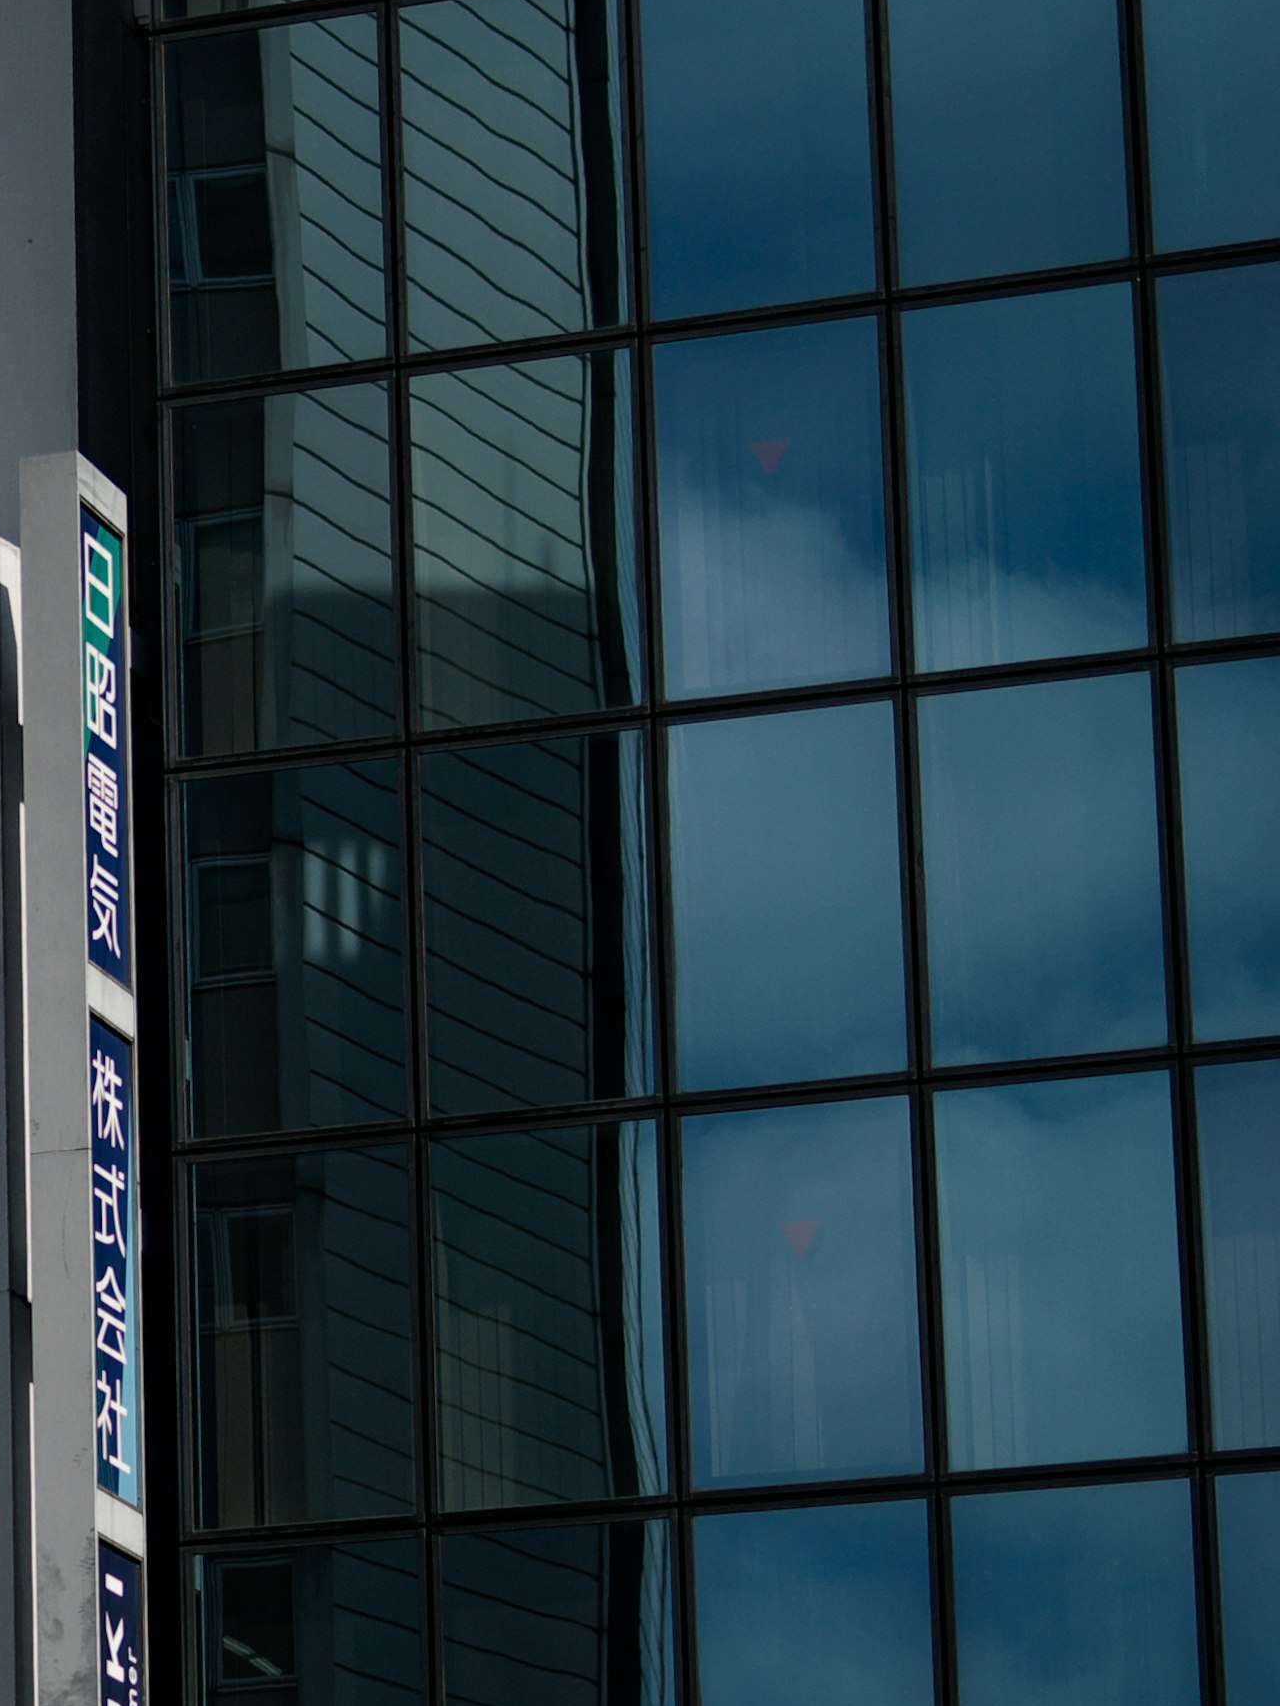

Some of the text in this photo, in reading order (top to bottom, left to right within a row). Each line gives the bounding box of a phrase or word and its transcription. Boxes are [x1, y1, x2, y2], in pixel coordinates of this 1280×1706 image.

[83, 531, 131, 1475] 日昭電気 株式会社
